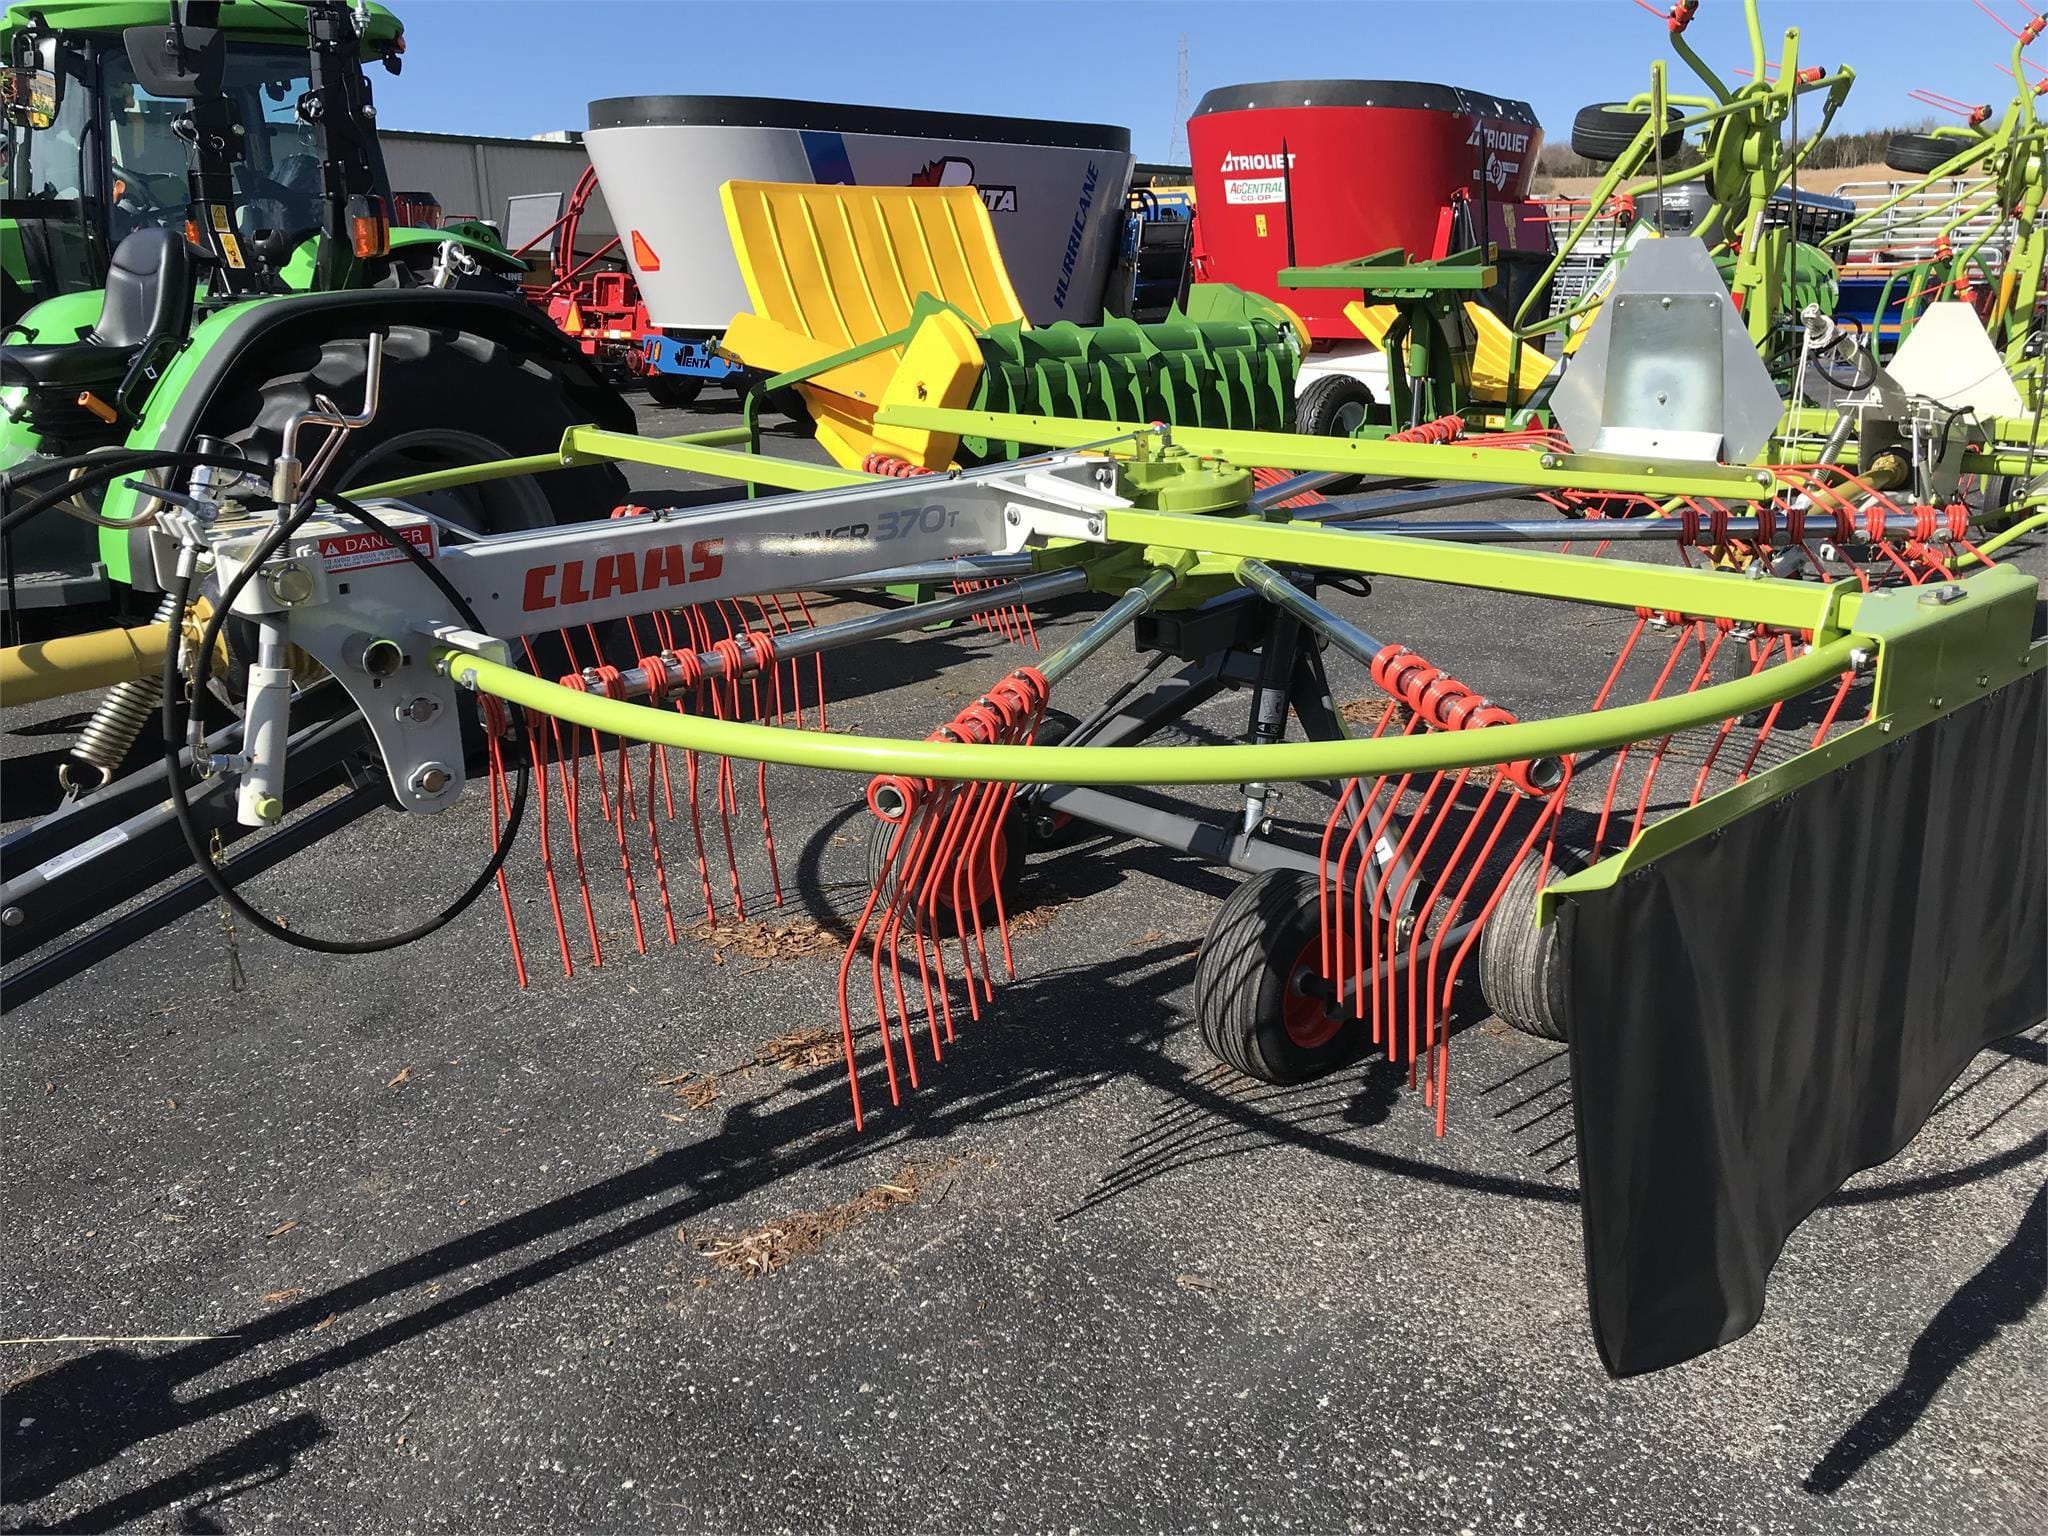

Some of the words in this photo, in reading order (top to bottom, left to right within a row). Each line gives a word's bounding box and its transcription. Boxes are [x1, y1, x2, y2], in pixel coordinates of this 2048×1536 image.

[1231, 153, 1296, 171] TRIOLIET
[1053, 160, 1099, 309] HURRICANE
[675, 345, 711, 369] PENTA
[522, 537, 724, 612] CLAAS
